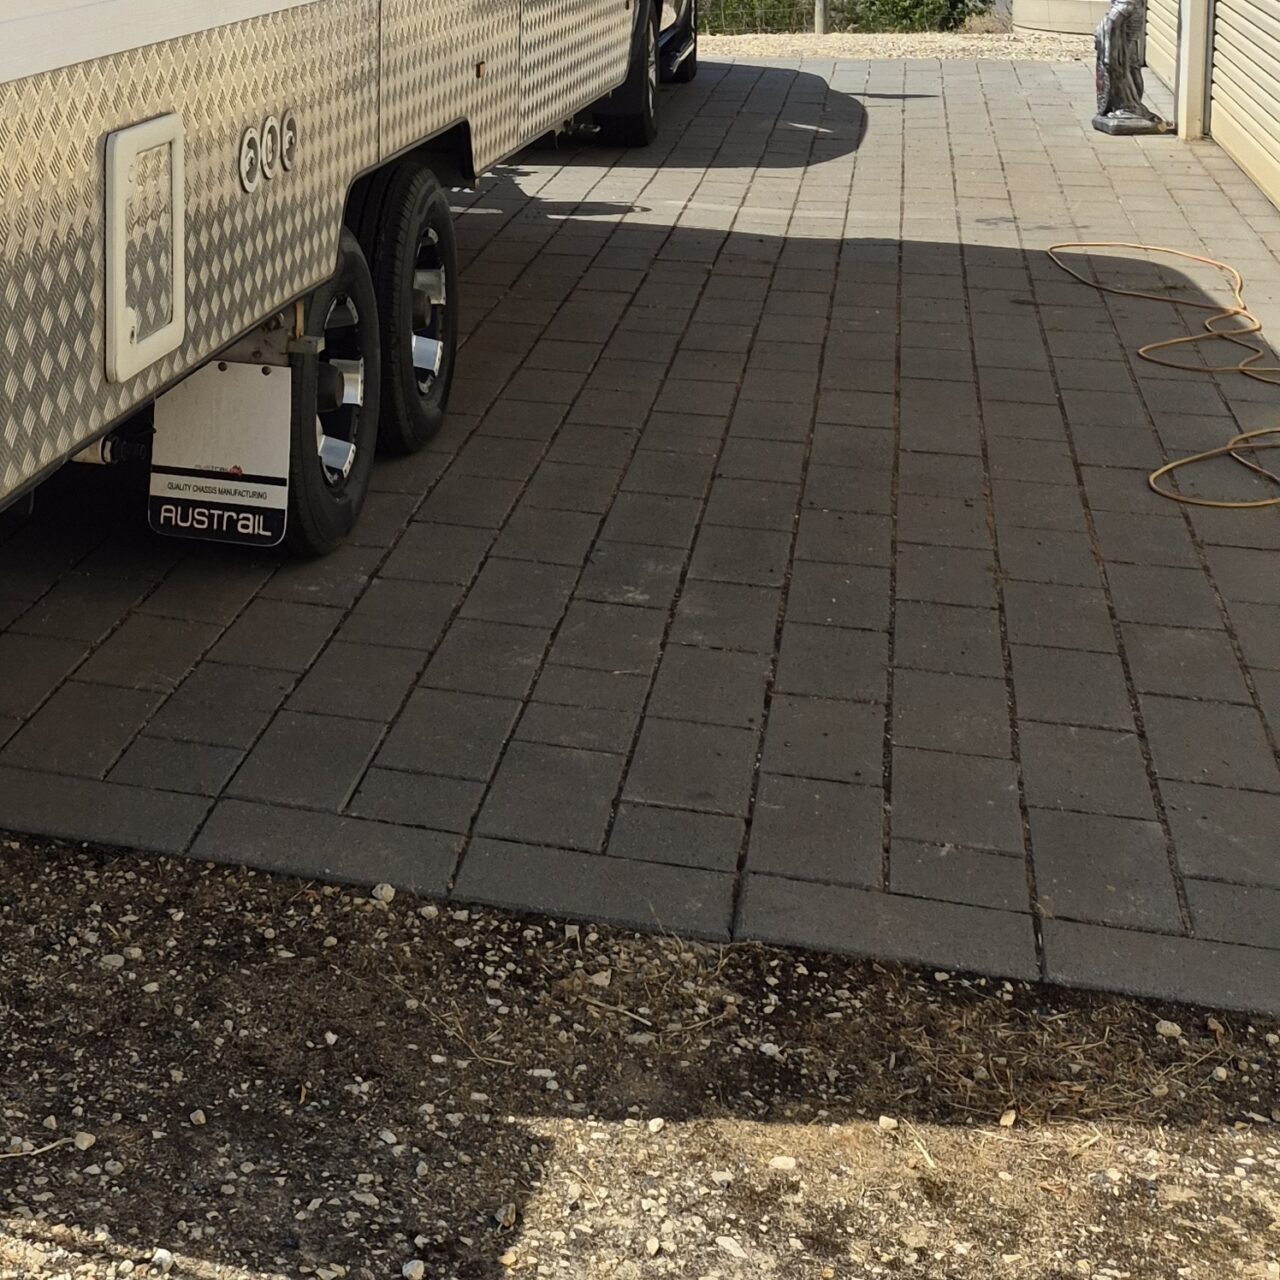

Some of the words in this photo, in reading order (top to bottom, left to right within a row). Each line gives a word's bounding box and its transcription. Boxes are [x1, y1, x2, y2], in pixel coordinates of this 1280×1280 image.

[166, 481, 192, 493] QUALITY
[192, 484, 218, 496] CHASSIS
[218, 487, 268, 501] MANUFACTURING
